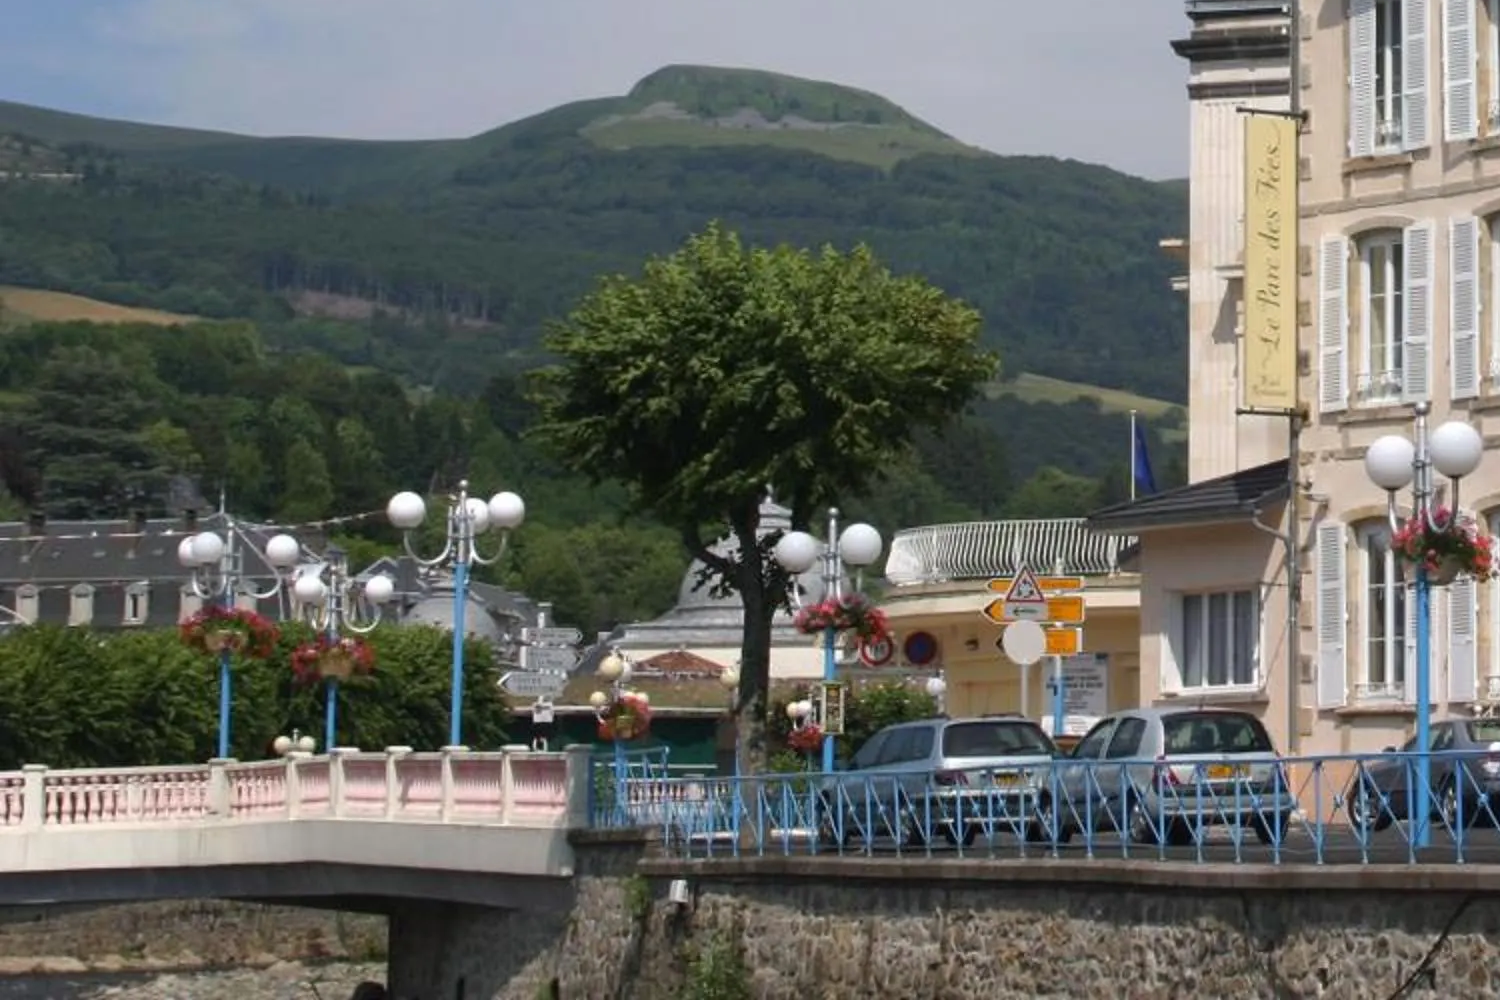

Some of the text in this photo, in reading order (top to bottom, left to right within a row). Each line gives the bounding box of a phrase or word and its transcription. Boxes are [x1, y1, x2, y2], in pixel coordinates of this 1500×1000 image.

[1254, 122, 1282, 368] Le Parc des Fées
